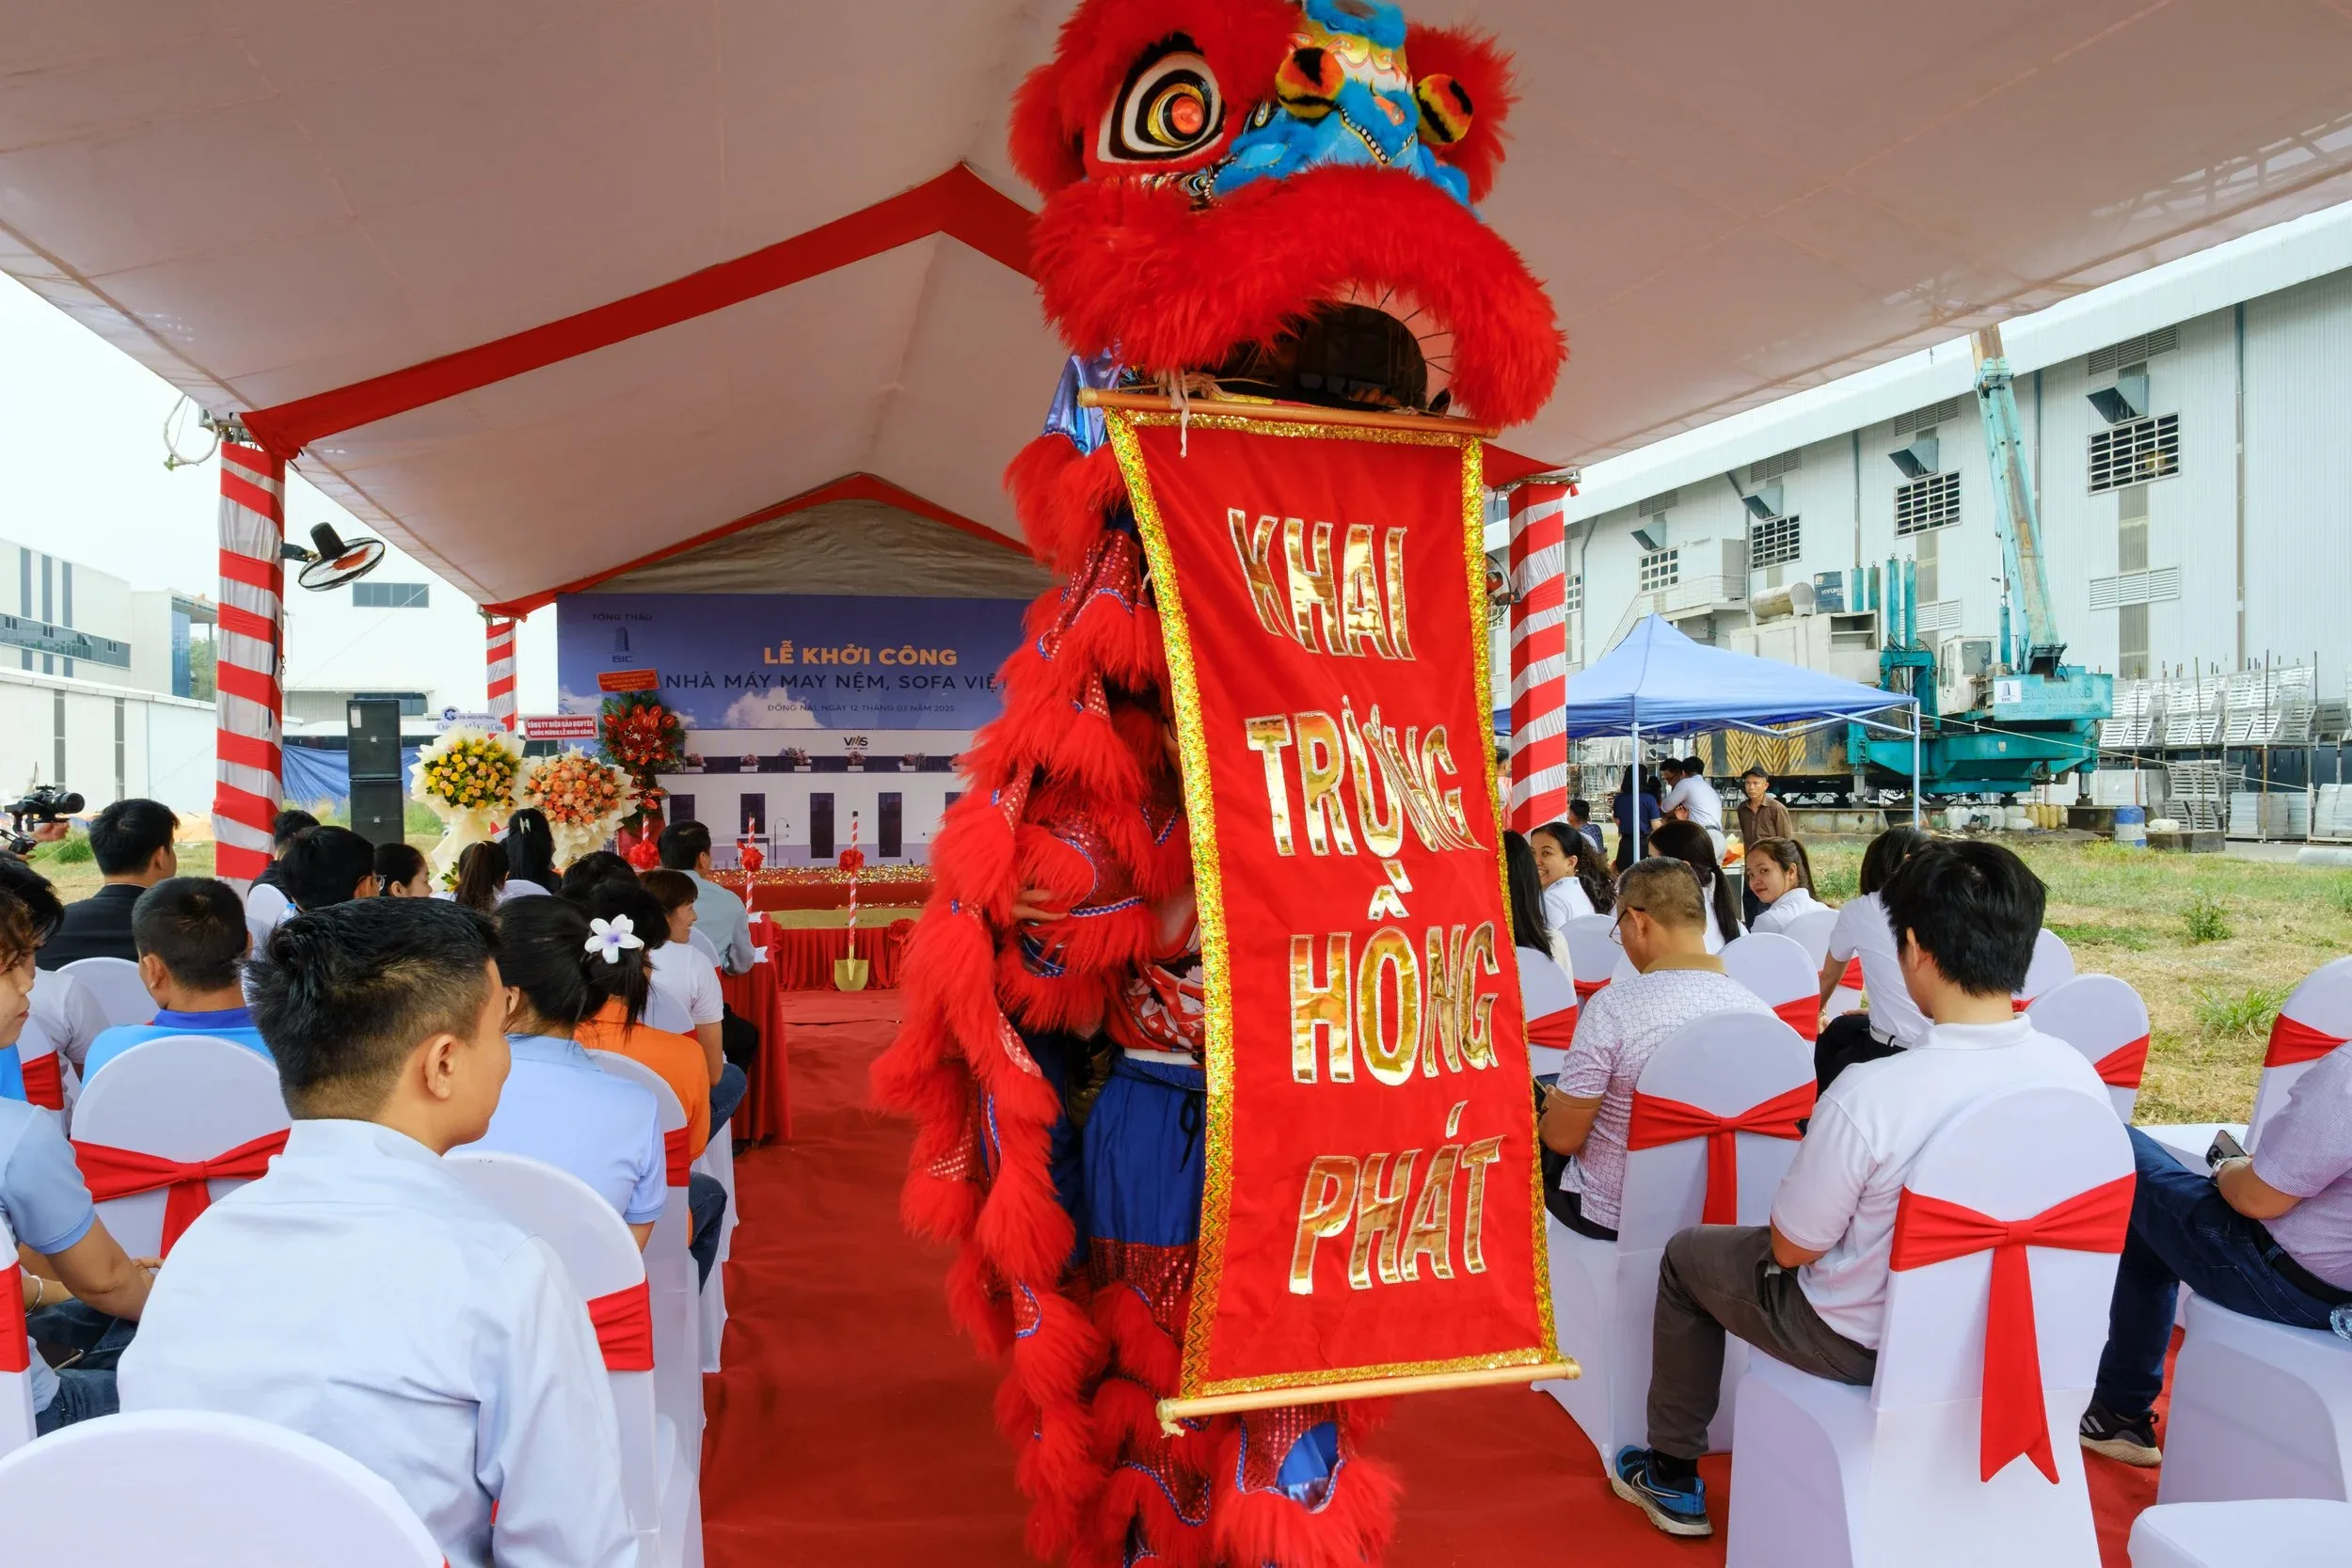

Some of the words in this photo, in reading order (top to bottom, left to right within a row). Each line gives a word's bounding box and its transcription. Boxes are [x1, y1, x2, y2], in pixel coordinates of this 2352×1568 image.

[764, 640, 794, 664] LỄ
[803, 643, 870, 665] KHỞI
[878, 644, 958, 666] CÔNG
[1228, 508, 1416, 661] KHAI
[666, 671, 716, 689] NHÀ
[723, 671, 771, 689] MÁY
[780, 673, 827, 689] MAY
[835, 672, 891, 692] NỆM,
[898, 674, 957, 689] SOFA
[963, 673, 1007, 693] VIỆ
[1289, 860, 1501, 1086] HỒNG
[1289, 1100, 1507, 1295] PHÁT
